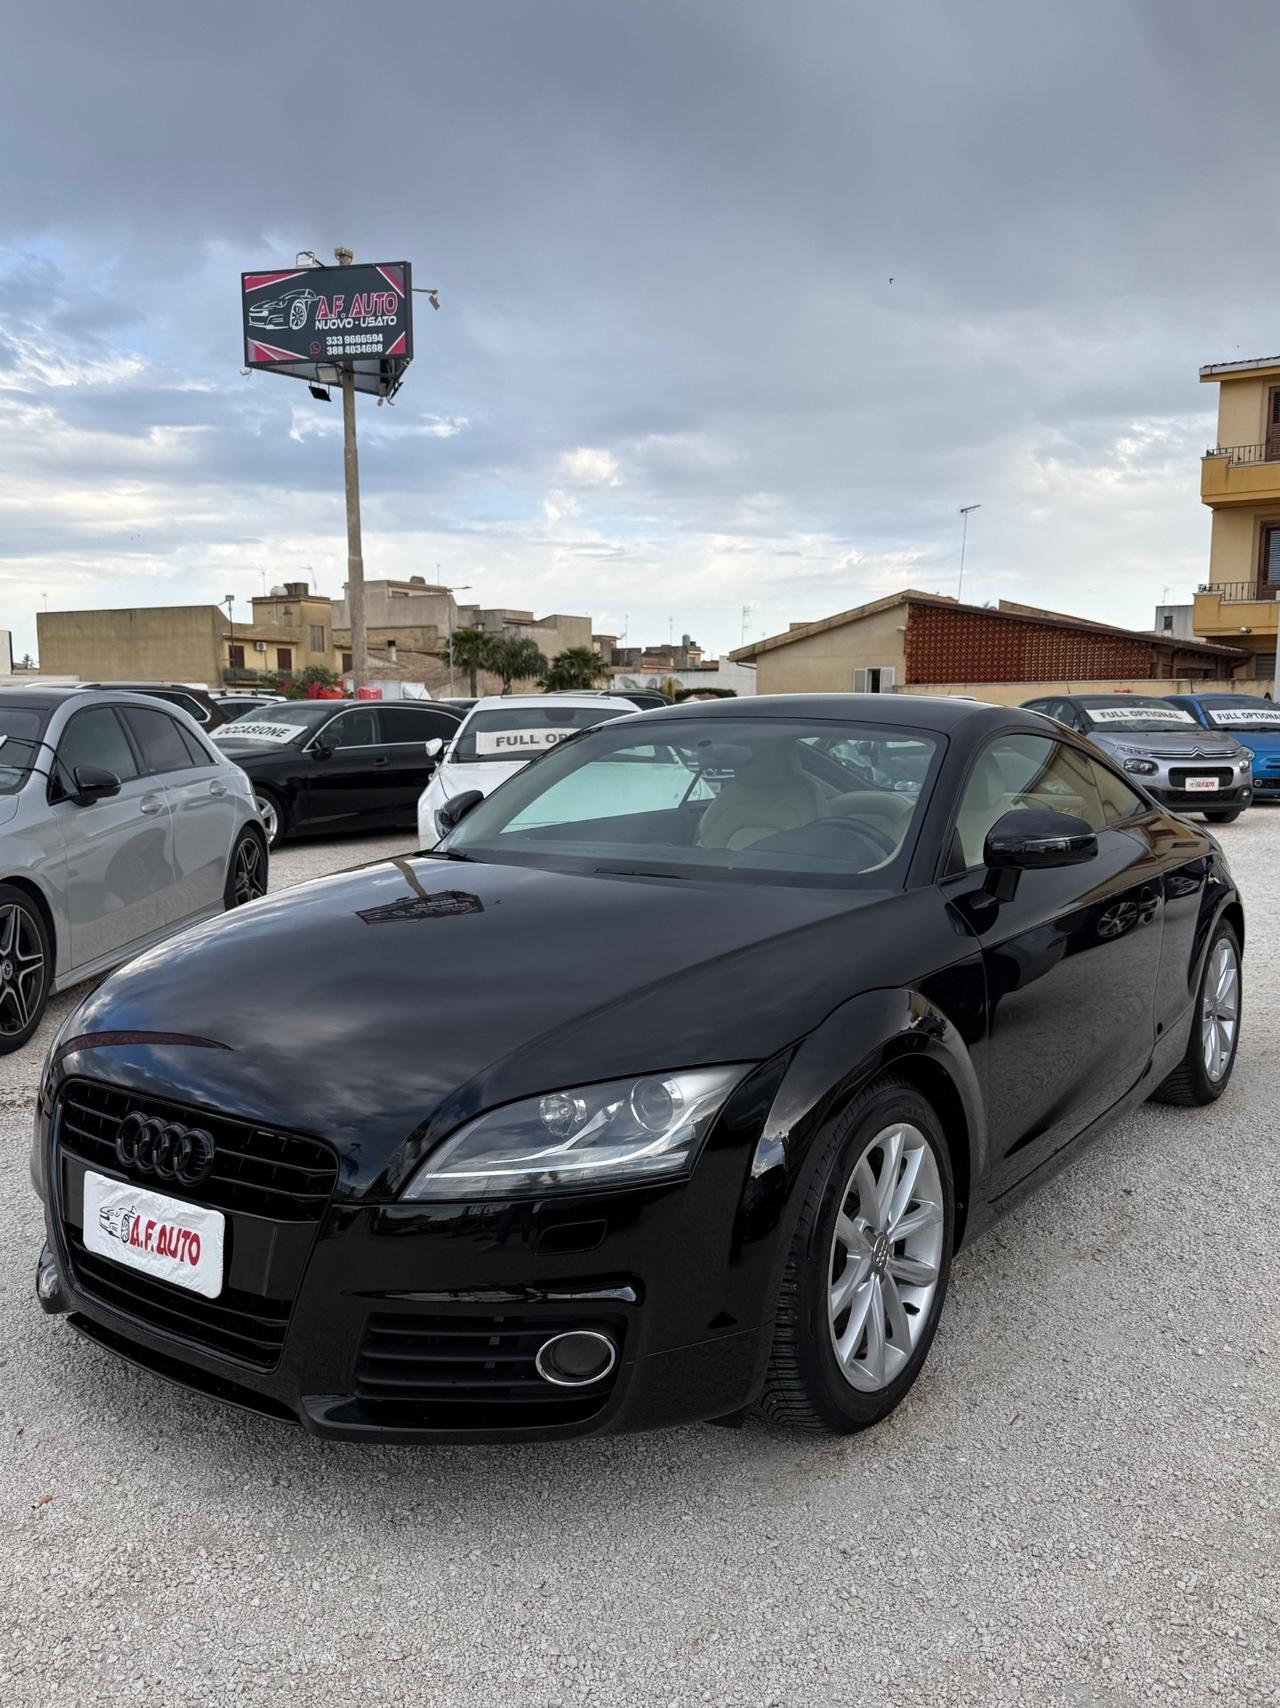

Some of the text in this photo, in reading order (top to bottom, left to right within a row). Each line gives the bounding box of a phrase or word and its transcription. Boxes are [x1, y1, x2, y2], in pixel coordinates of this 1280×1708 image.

[349, 291, 398, 317] AUTO
[315, 318, 354, 330] NUOVO
[360, 315, 397, 327] USATO
[326, 336, 343, 345] 333
[1216, 712, 1241, 720] FULL
[495, 734, 540, 747] FULL
[156, 1224, 201, 1266] AUTO
